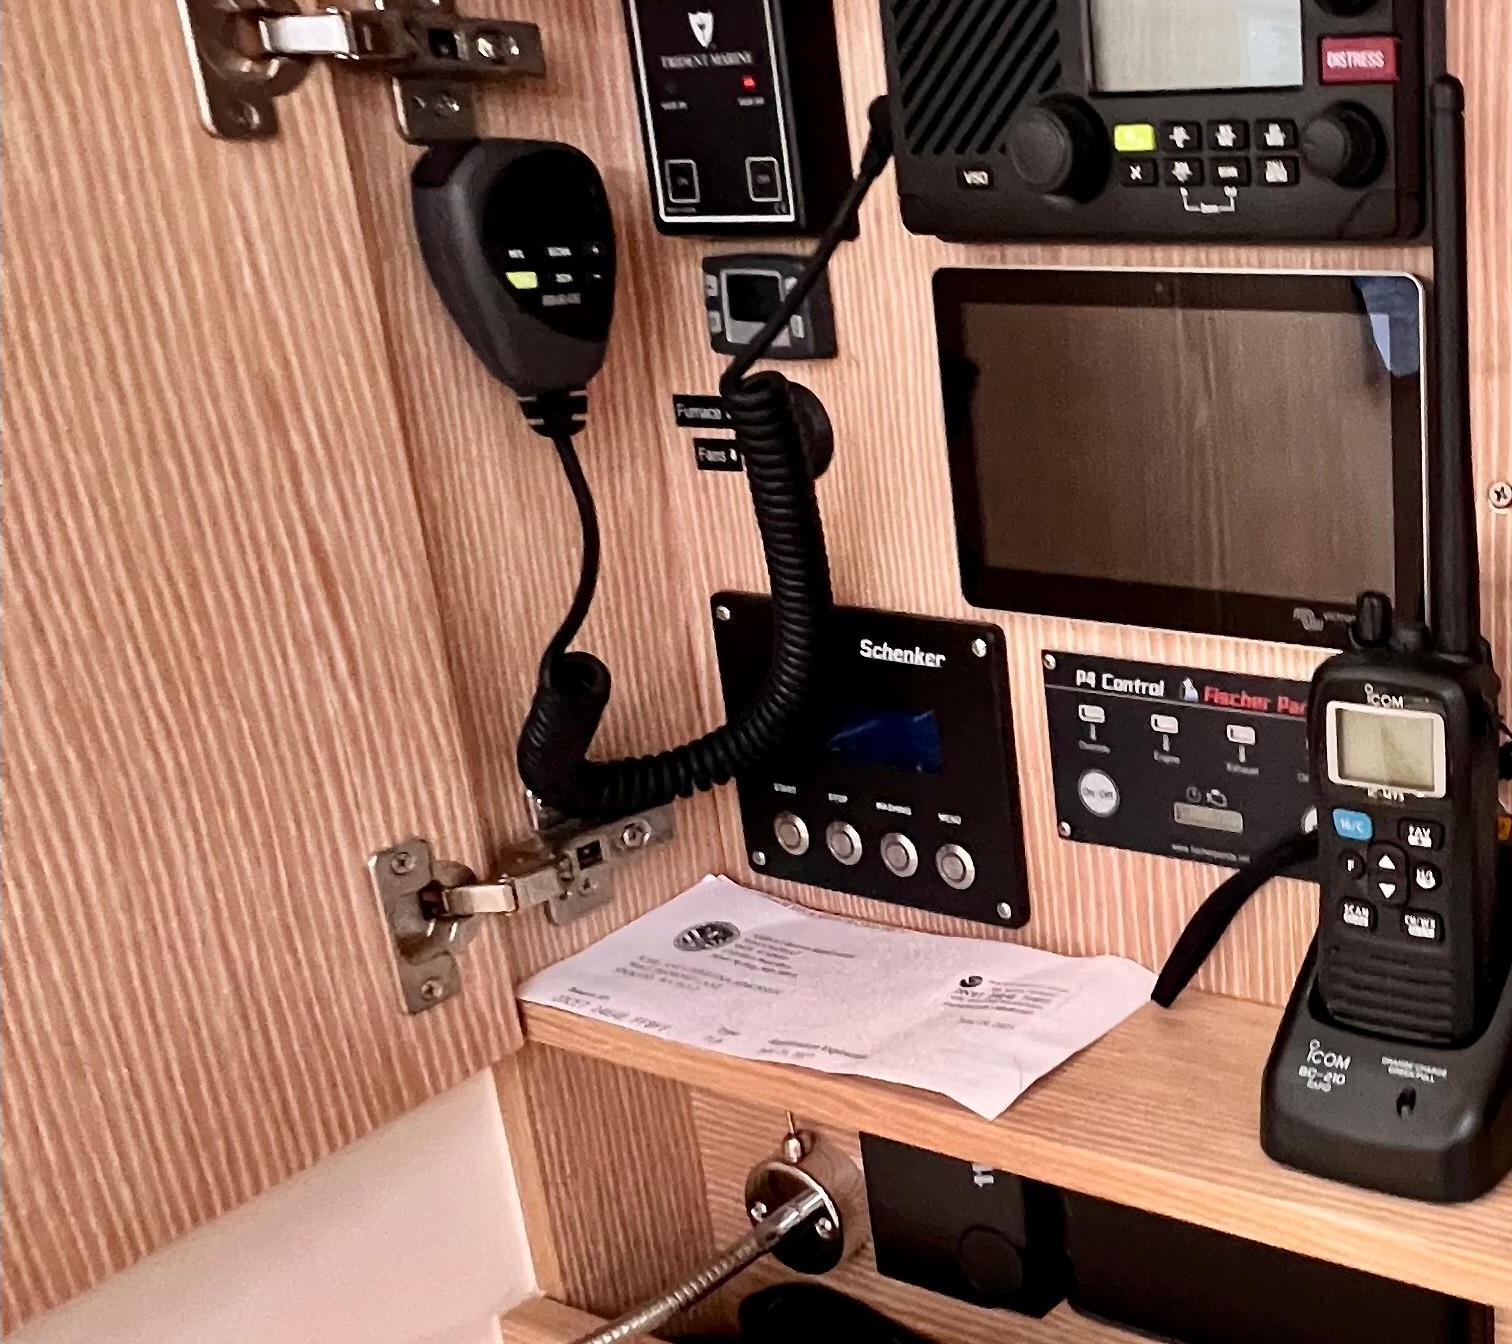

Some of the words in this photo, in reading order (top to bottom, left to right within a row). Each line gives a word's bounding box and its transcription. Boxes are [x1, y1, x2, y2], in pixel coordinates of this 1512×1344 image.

[1326, 50, 1386, 70] DISTRESS
[860, 639, 946, 668] Schenker
[1076, 668, 1096, 690] P4
[1101, 672, 1165, 698] Control
[1203, 686, 1272, 711] Fischer
